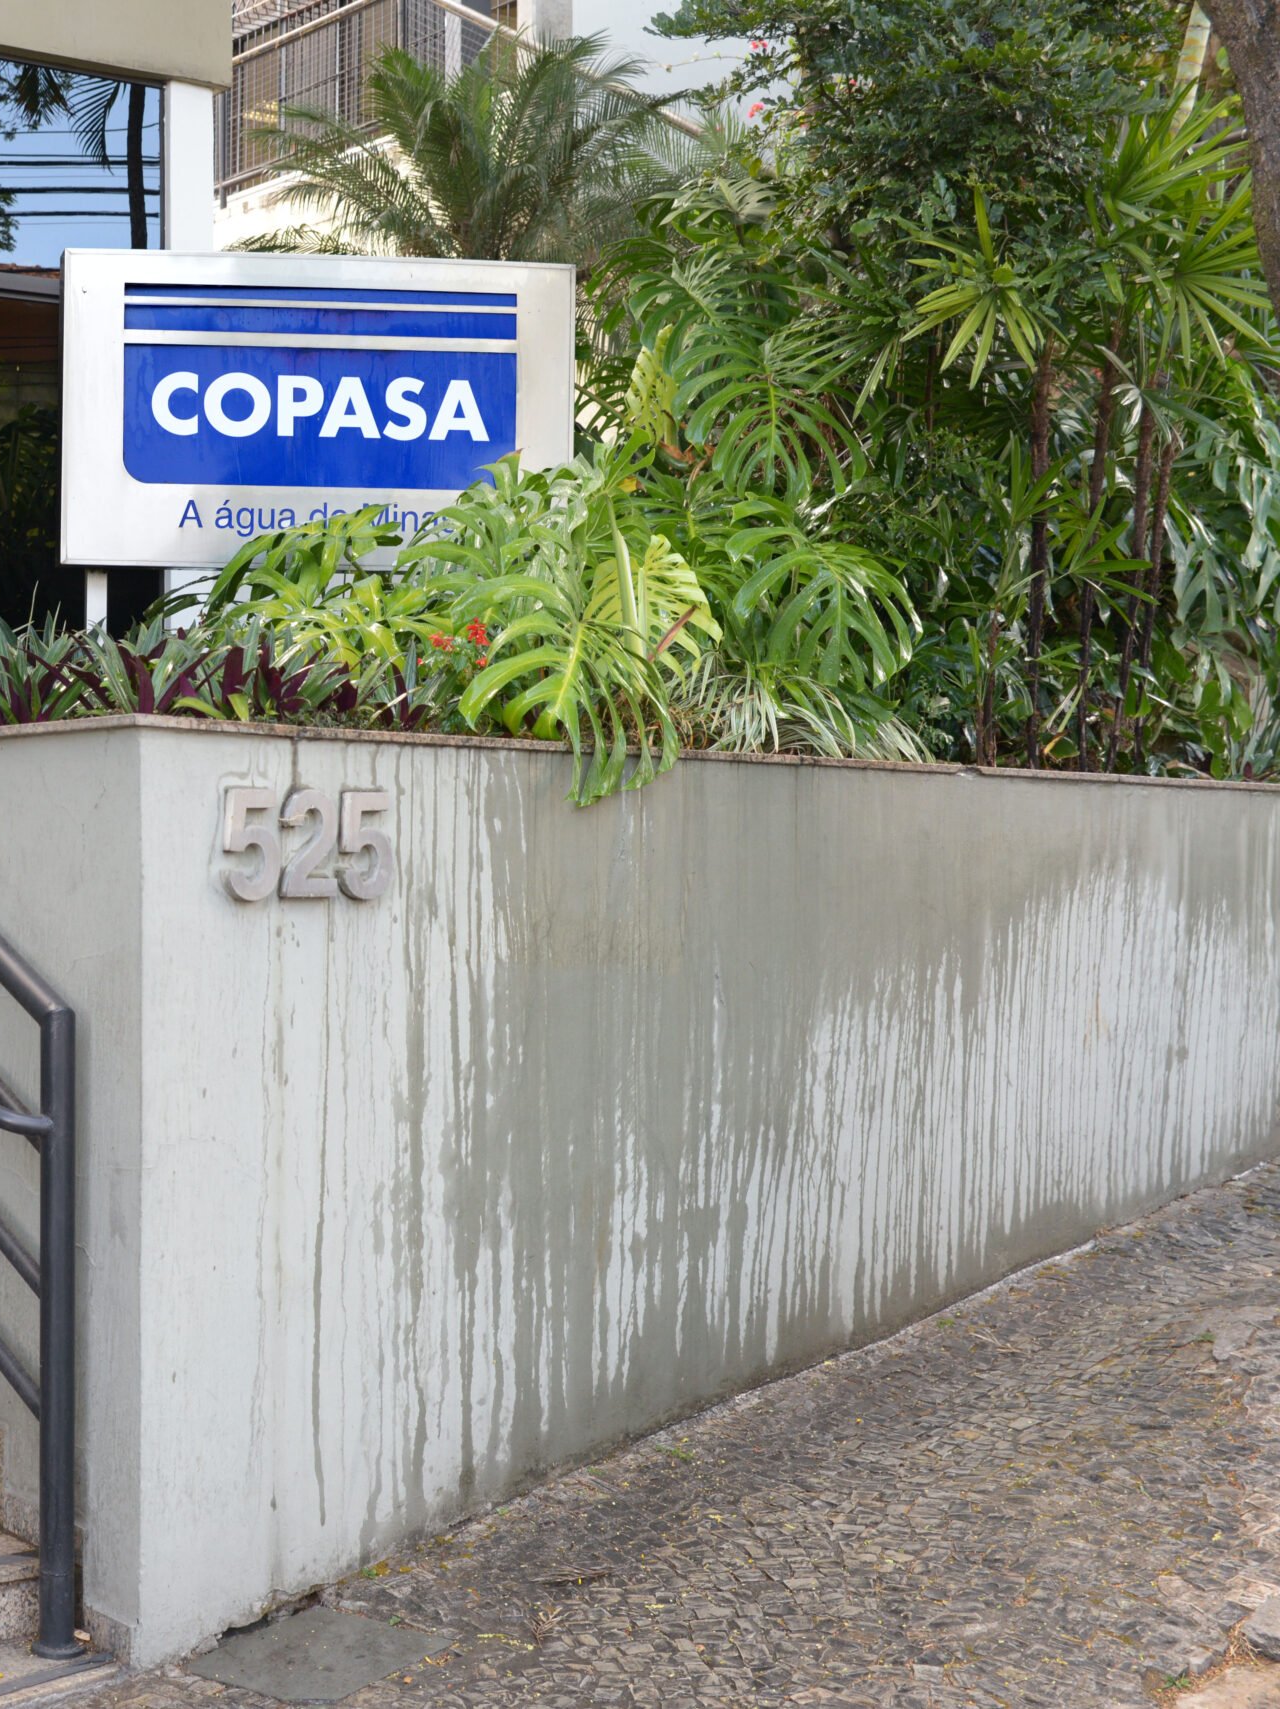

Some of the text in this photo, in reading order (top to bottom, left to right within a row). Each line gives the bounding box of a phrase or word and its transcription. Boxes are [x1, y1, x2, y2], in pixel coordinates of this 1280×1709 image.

[151, 371, 490, 442] COPASA
[178, 500, 203, 528] A
[214, 500, 296, 537] água
[223, 788, 394, 901] 525
